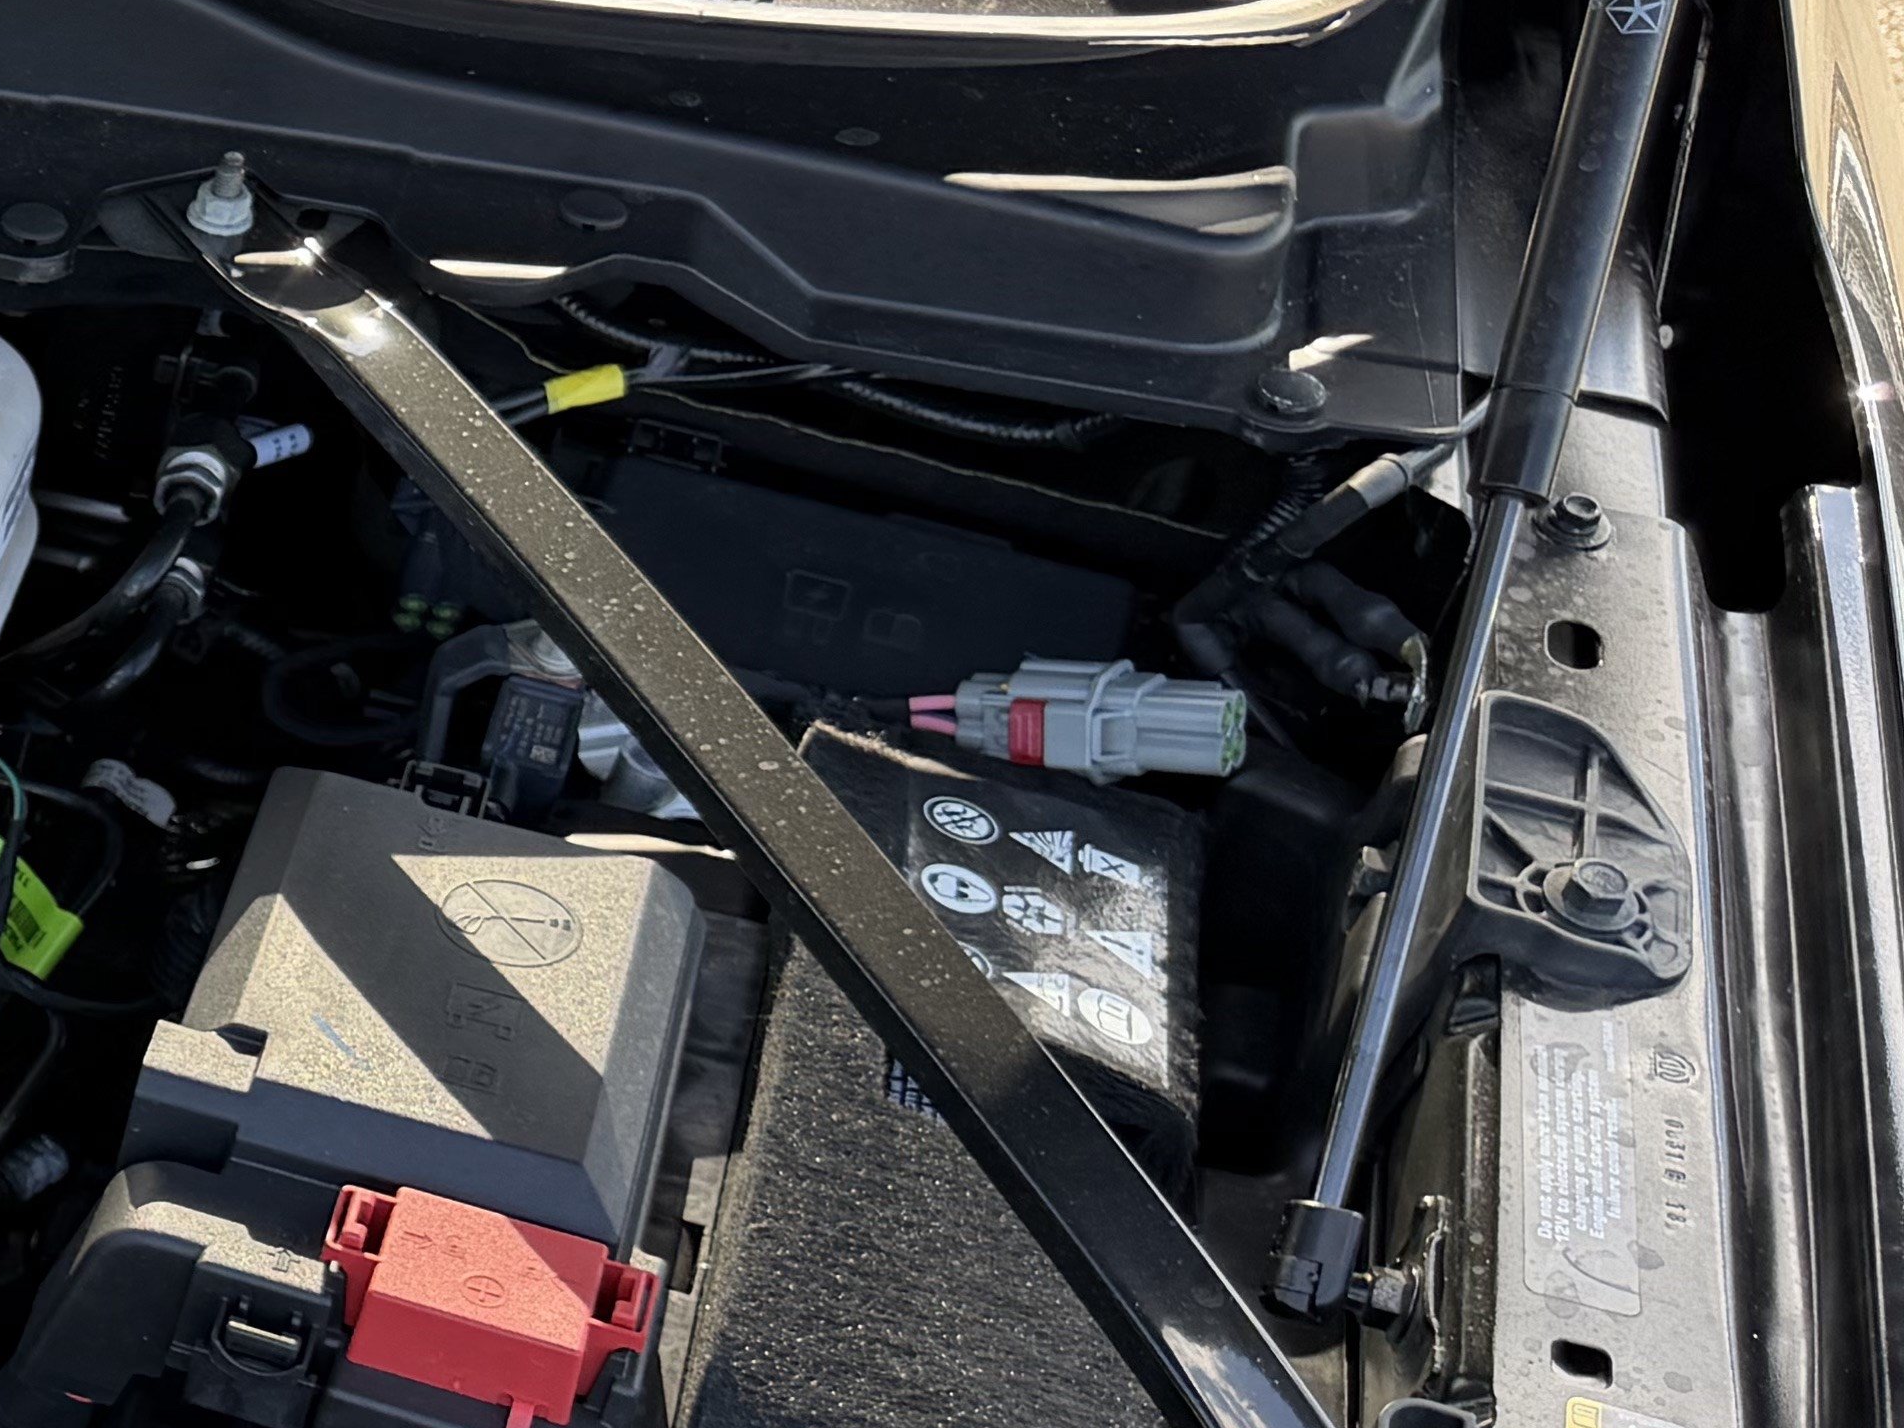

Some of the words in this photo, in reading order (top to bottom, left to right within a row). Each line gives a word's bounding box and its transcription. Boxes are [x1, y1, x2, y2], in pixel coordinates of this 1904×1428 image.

[1538, 1194, 1553, 1217] not
[1556, 1197, 1569, 1213] to
[1589, 1194, 1607, 1239] Engine
[1536, 1220, 1553, 1239] Do
[1555, 1215, 1570, 1242] 12V
